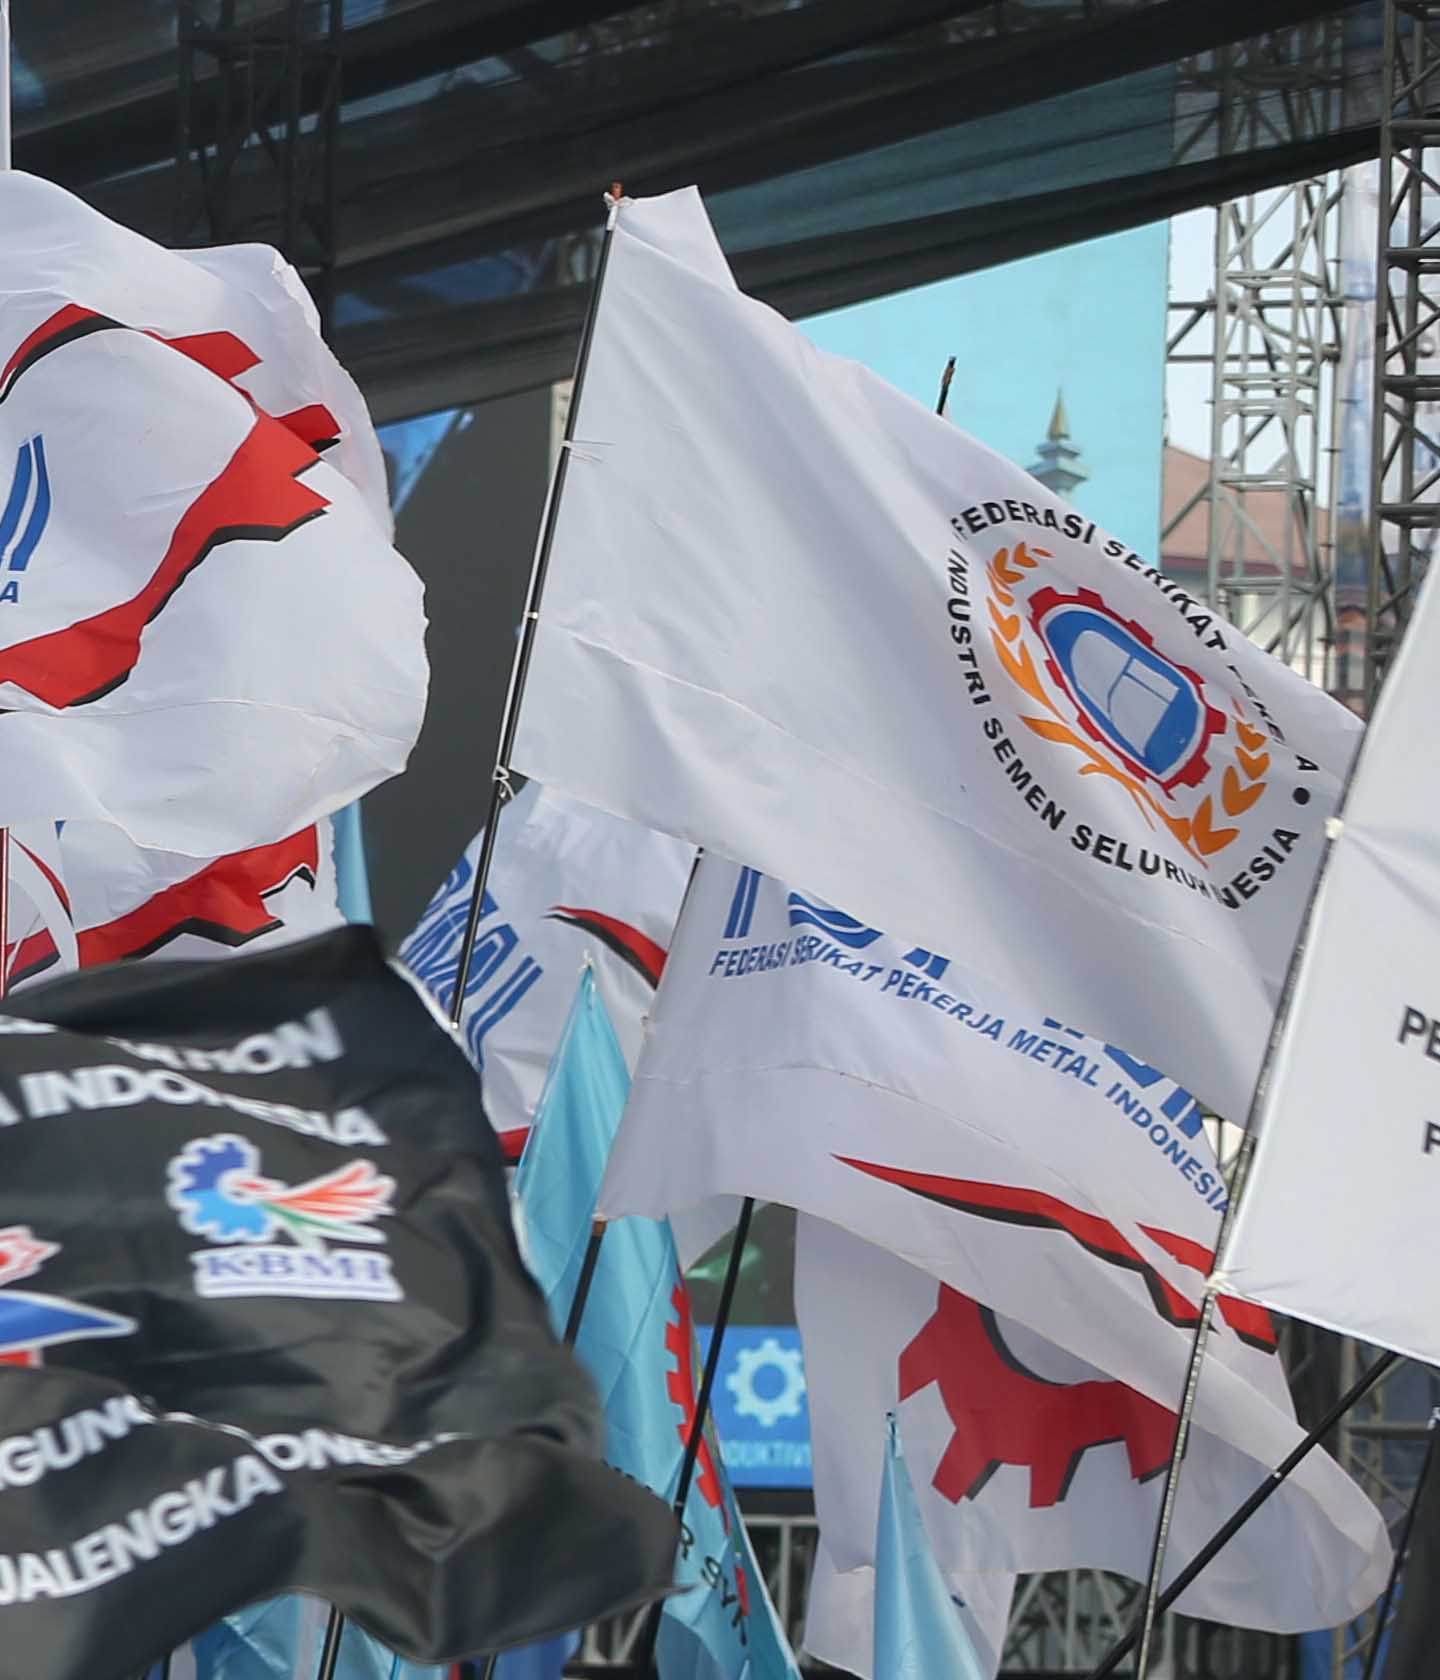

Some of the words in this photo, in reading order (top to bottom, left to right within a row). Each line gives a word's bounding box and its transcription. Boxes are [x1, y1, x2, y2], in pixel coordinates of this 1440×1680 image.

[947, 550, 992, 706] INDUSTRI
[983, 717, 1067, 830] SEMEN
[709, 944, 792, 979] FEDERASI
[792, 935, 881, 983] SERIKAT
[881, 969, 1007, 1041] PEKERJA
[1007, 1029, 1100, 1088] METAL
